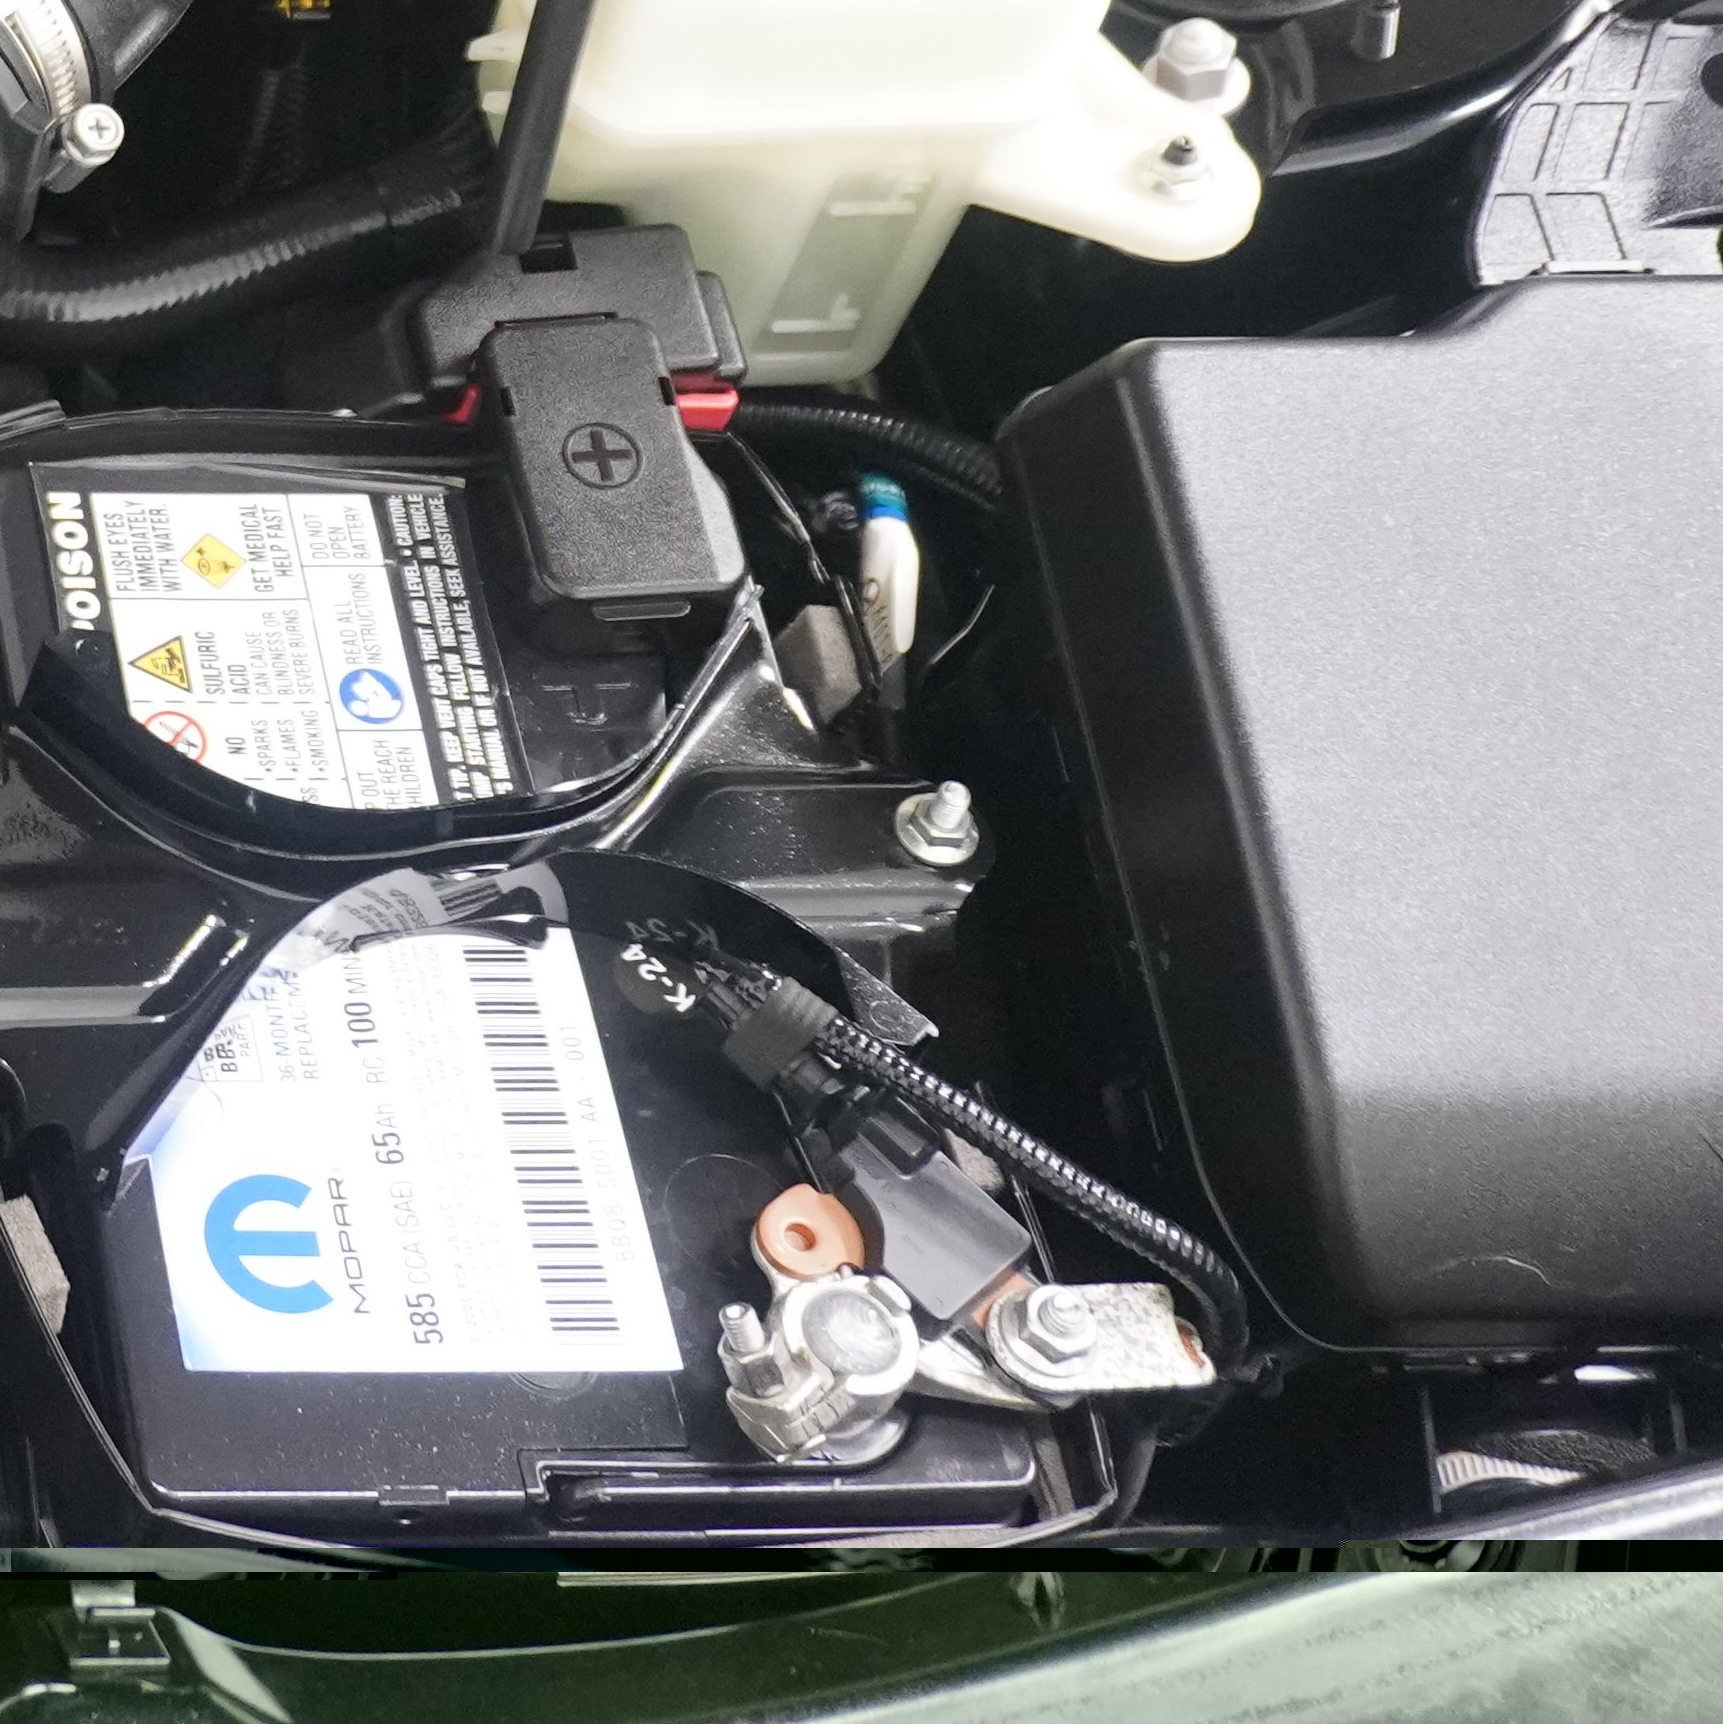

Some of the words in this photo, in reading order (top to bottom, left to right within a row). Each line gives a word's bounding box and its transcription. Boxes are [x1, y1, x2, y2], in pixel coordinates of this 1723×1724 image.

[104, 512, 127, 545] EYES
[153, 504, 173, 553] WATER.
[240, 504, 268, 562] MEDICAL
[262, 507, 283, 539] FAST
[304, 513, 324, 538] NOT
[345, 504, 371, 559] BATTERY.
[389, 495, 413, 546] CAUTION:
[407, 494, 432, 539] VEHICLE
[429, 494, 460, 565] ASSISTANCE.
[124, 501, 156, 592] IMMEDIATELY
[271, 544, 294, 577] HELP
[310, 542, 329, 559] DO
[329, 526, 349, 559] OPEN
[419, 546, 436, 558] IN
[111, 550, 136, 591] FLUSH
[161, 556, 182, 592] WITH
[254, 565, 274, 593] GET
[403, 559, 425, 596] LEVEL.
[444, 568, 466, 597] SEEK
[263, 612, 280, 627] OR
[333, 601, 352, 625] ALL
[351, 571, 384, 664] INSTRUCTIONS.
[412, 599, 433, 624] AND
[427, 565, 457, 646] INSTRUCTIONS
[284, 605, 309, 647] BURNS.
[419, 627, 440, 661] TIGHT
[453, 600, 484, 665] AVAILABLE,
[195, 631, 225, 695] SULFURIC
[246, 631, 268, 668] CAUSE
[268, 631, 294, 696] BLINDNESS
[339, 629, 362, 664] READ
[228, 664, 251, 695] ACID
[254, 672, 272, 695] CAN
[294, 651, 315, 695] SEVERE
[428, 664, 449, 695] CAPS
[442, 653, 470, 699] FOLLOW
[467, 668, 489, 691] NOT
[436, 696, 457, 728] VENT
[475, 695, 492, 705] IF
[477, 709, 497, 726] OR
[226, 737, 246, 754] NO
[441, 731, 465, 762] KEEP
[454, 707, 487, 765] STARTING
[481, 729, 511, 778] MANUAL
[373, 740, 399, 783] REACH
[449, 765, 471, 788] TIP.
[358, 772, 379, 796] OUT
[620, 943, 696, 1013] K-24
[343, 1001, 380, 1049] 100
[559, 1023, 586, 1062] 001
[364, 1056, 388, 1084] RC
[577, 1096, 599, 1123] AA
[586, 1137, 618, 1188] 5001
[390, 1180, 421, 1234] (SAE)
[327, 1177, 370, 1314] MOPAR
[403, 1242, 431, 1284] CCA
[406, 1293, 444, 1344] 585
